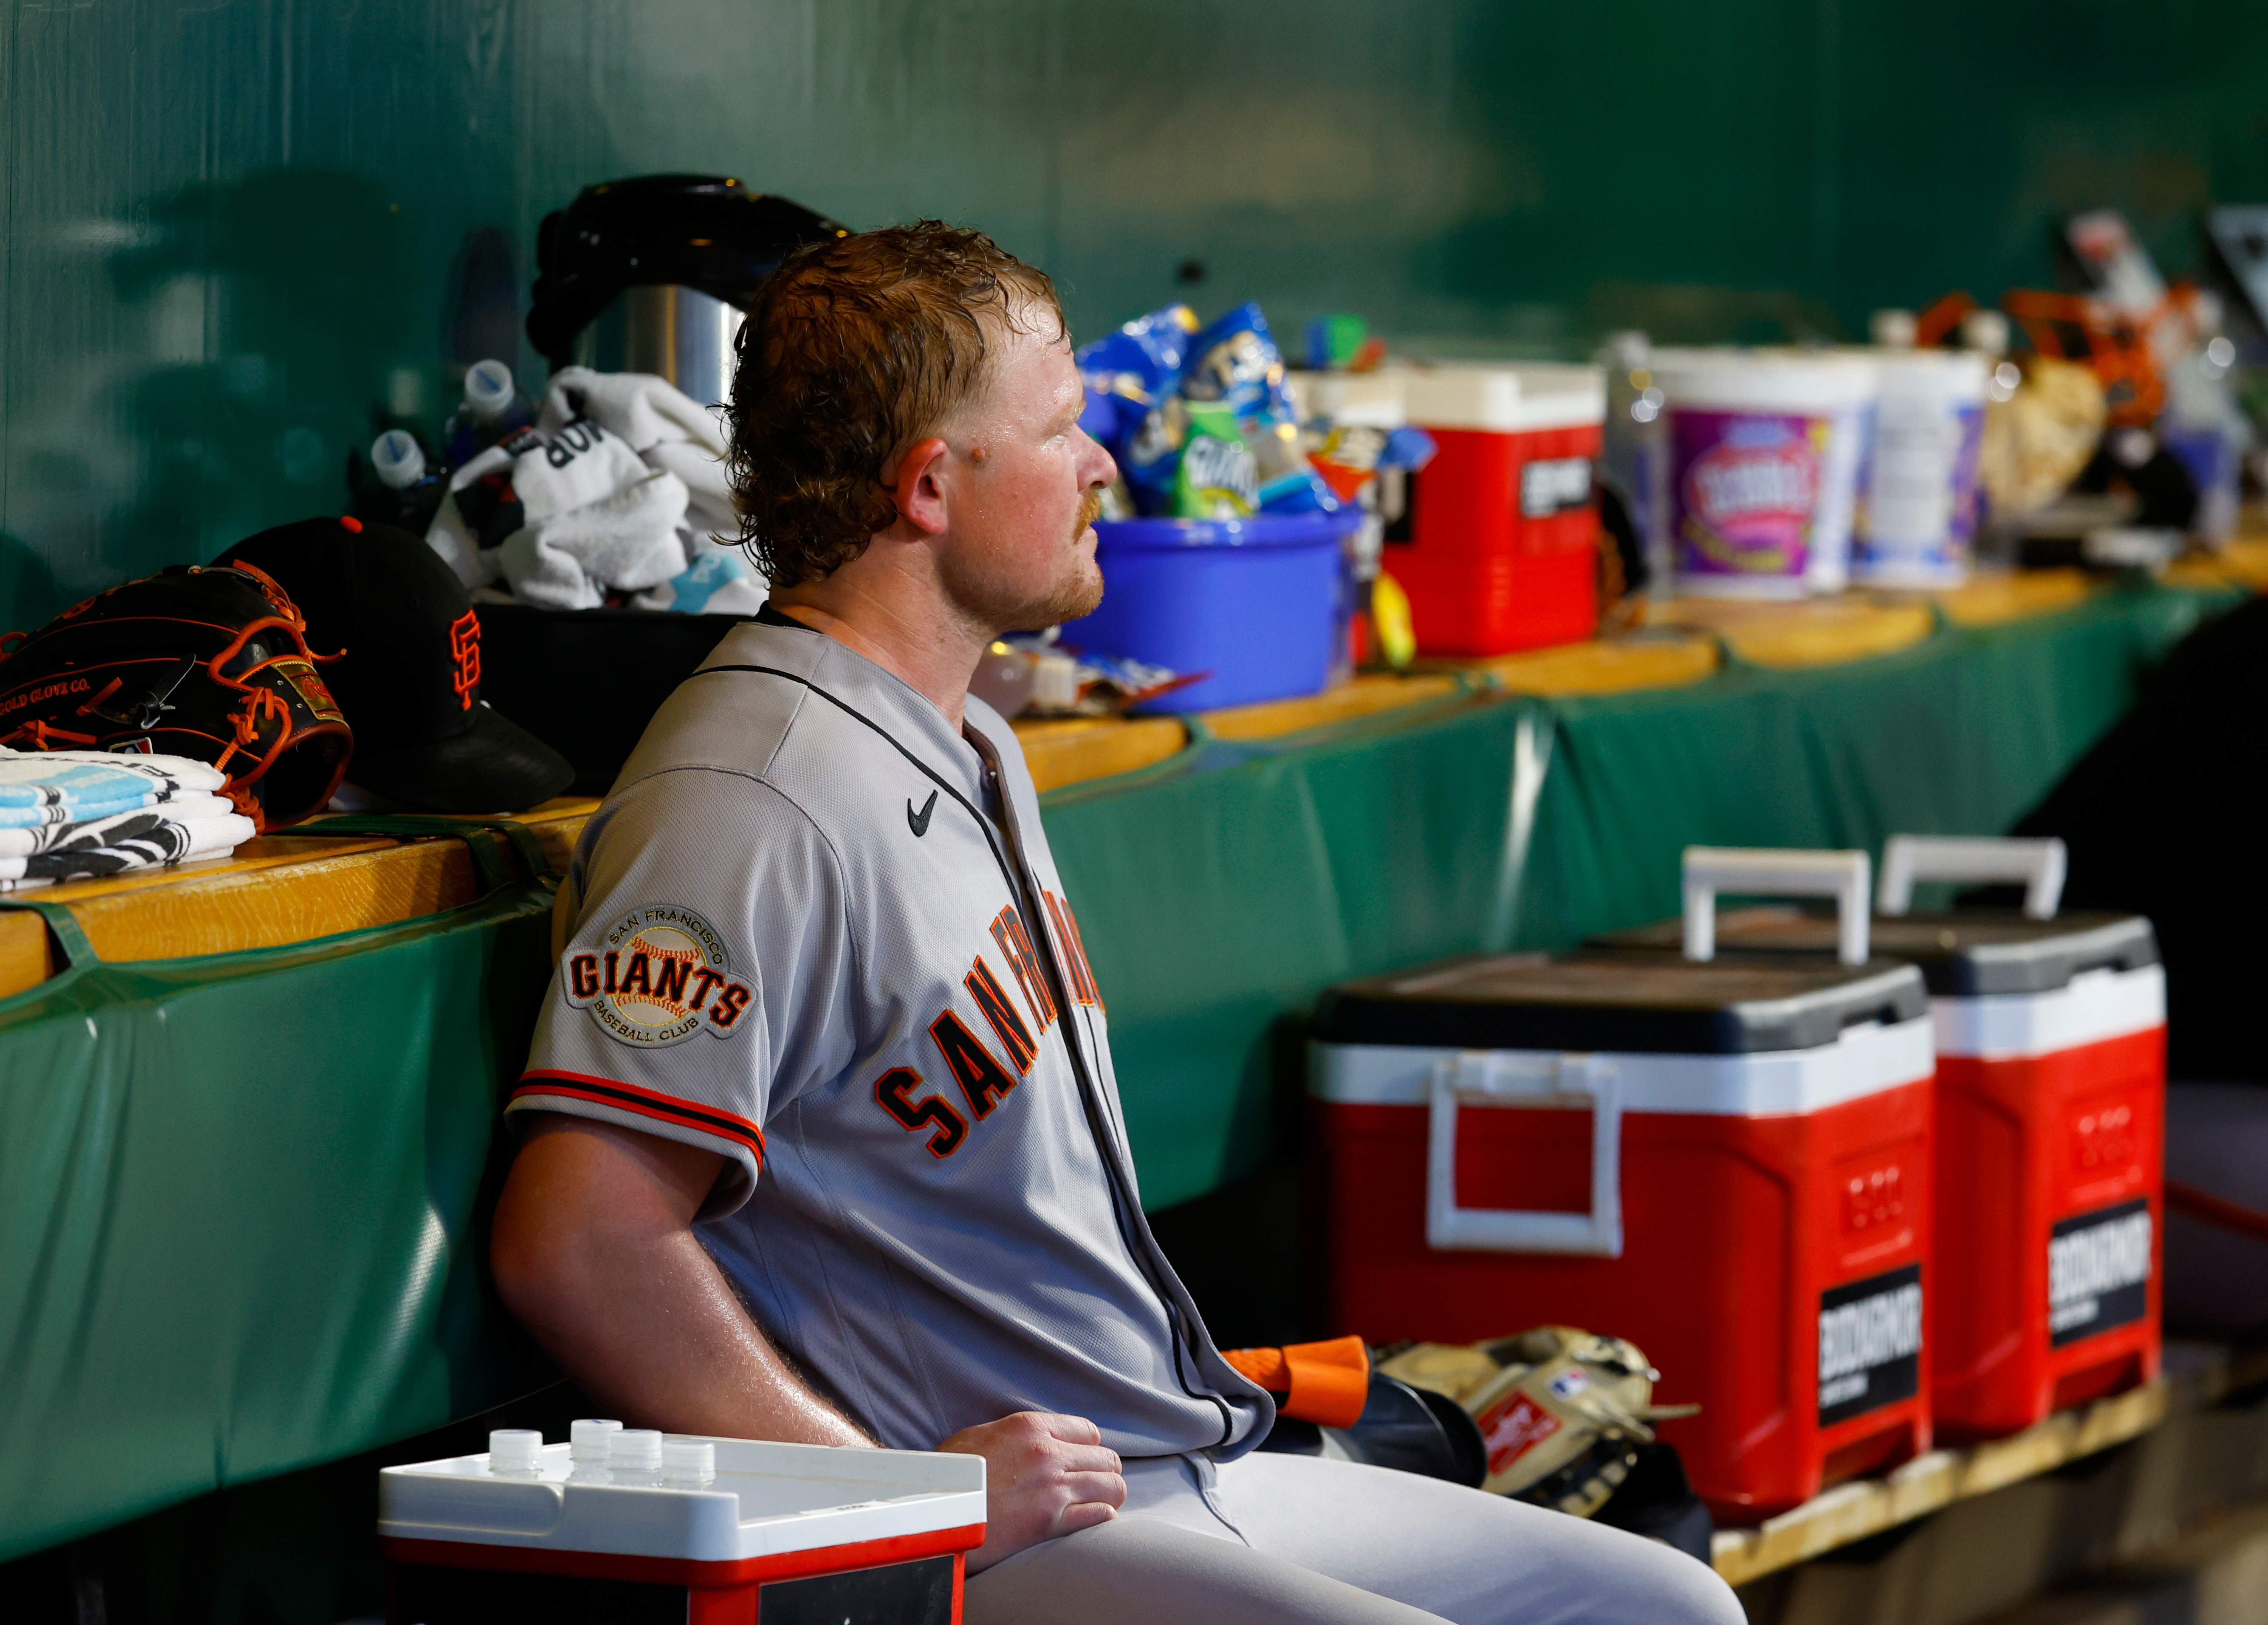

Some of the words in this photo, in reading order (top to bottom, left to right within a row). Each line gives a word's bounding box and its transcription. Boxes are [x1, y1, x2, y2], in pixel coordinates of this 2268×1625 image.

[0, 694, 28, 716] GOLD
[30, 682, 69, 703] GLOVE
[70, 678, 91, 693] CO.
[609, 916, 641, 945] SAN
[644, 910, 723, 964] FRANCISCO
[570, 950, 752, 1029] GIANTS
[593, 1000, 655, 1043] BASEBALL
[659, 1017, 699, 1040] CLUB
[874, 955, 1039, 1159] SAN
